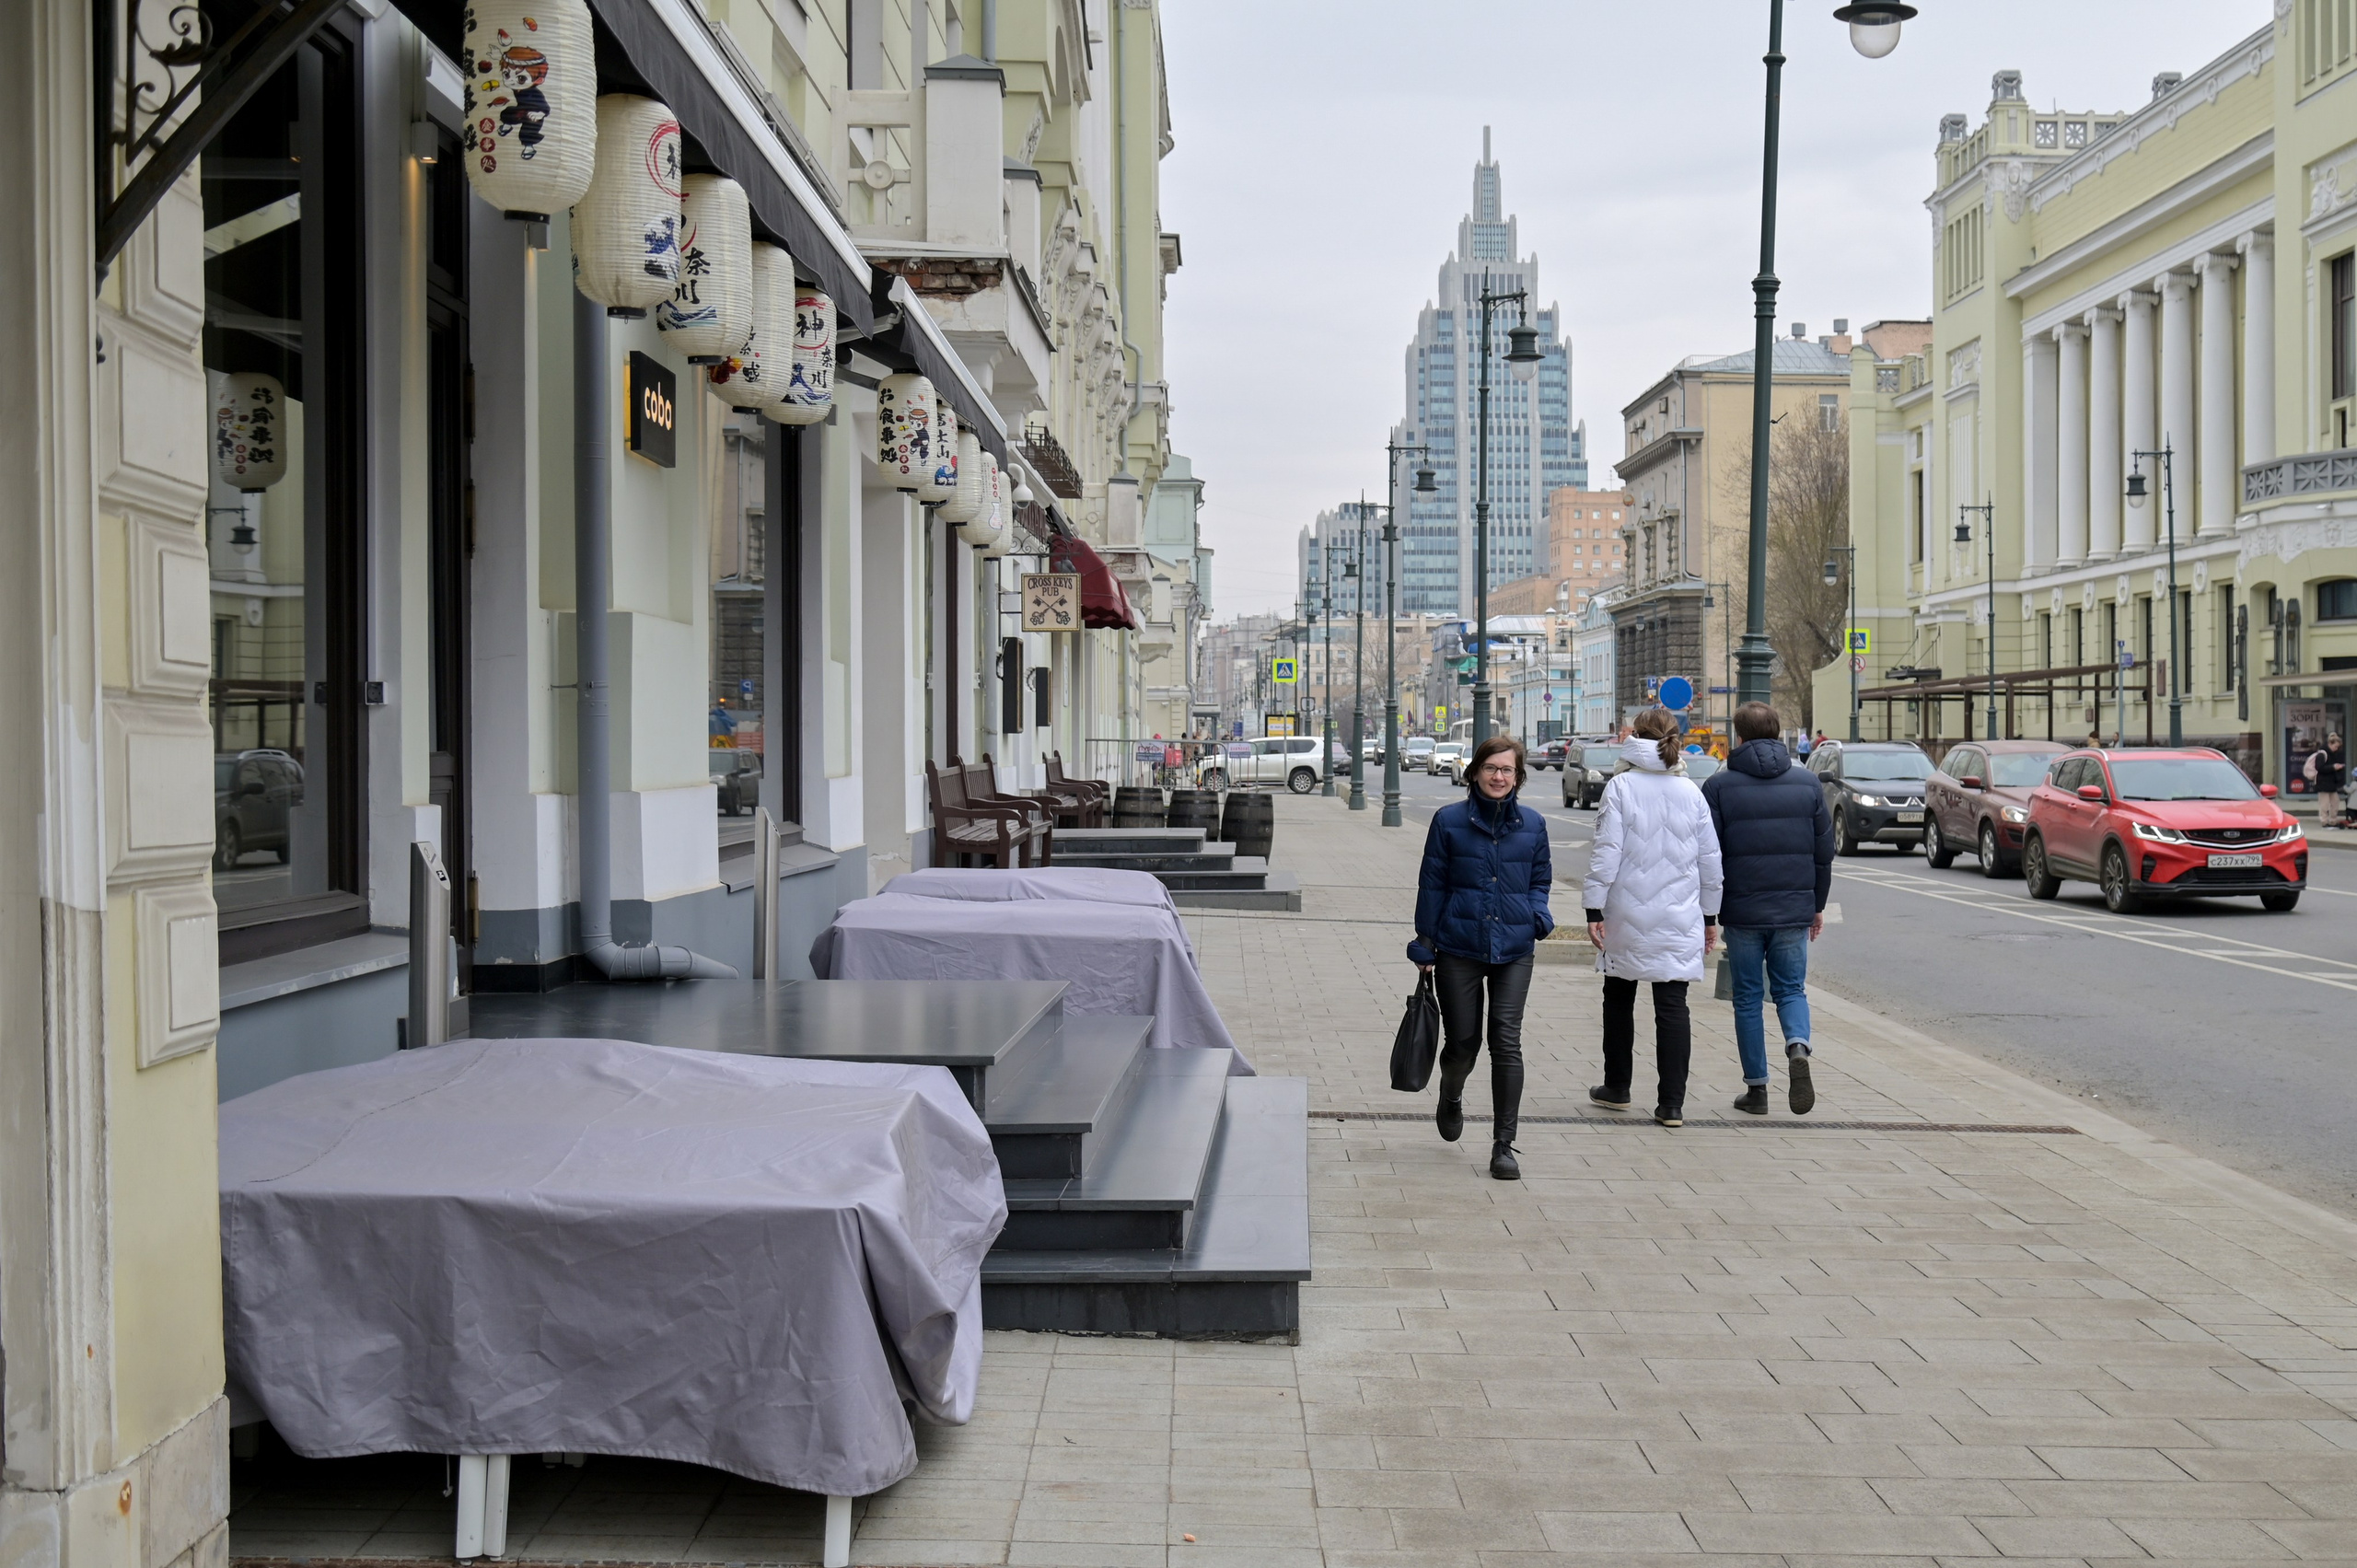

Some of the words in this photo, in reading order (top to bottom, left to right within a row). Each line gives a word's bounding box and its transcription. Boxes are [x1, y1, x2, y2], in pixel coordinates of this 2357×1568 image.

[644, 381, 672, 431] coba
[1028, 577, 1051, 589] CROSS
[1053, 577, 1073, 589] KEYS
[1042, 587, 1059, 596] PUB
